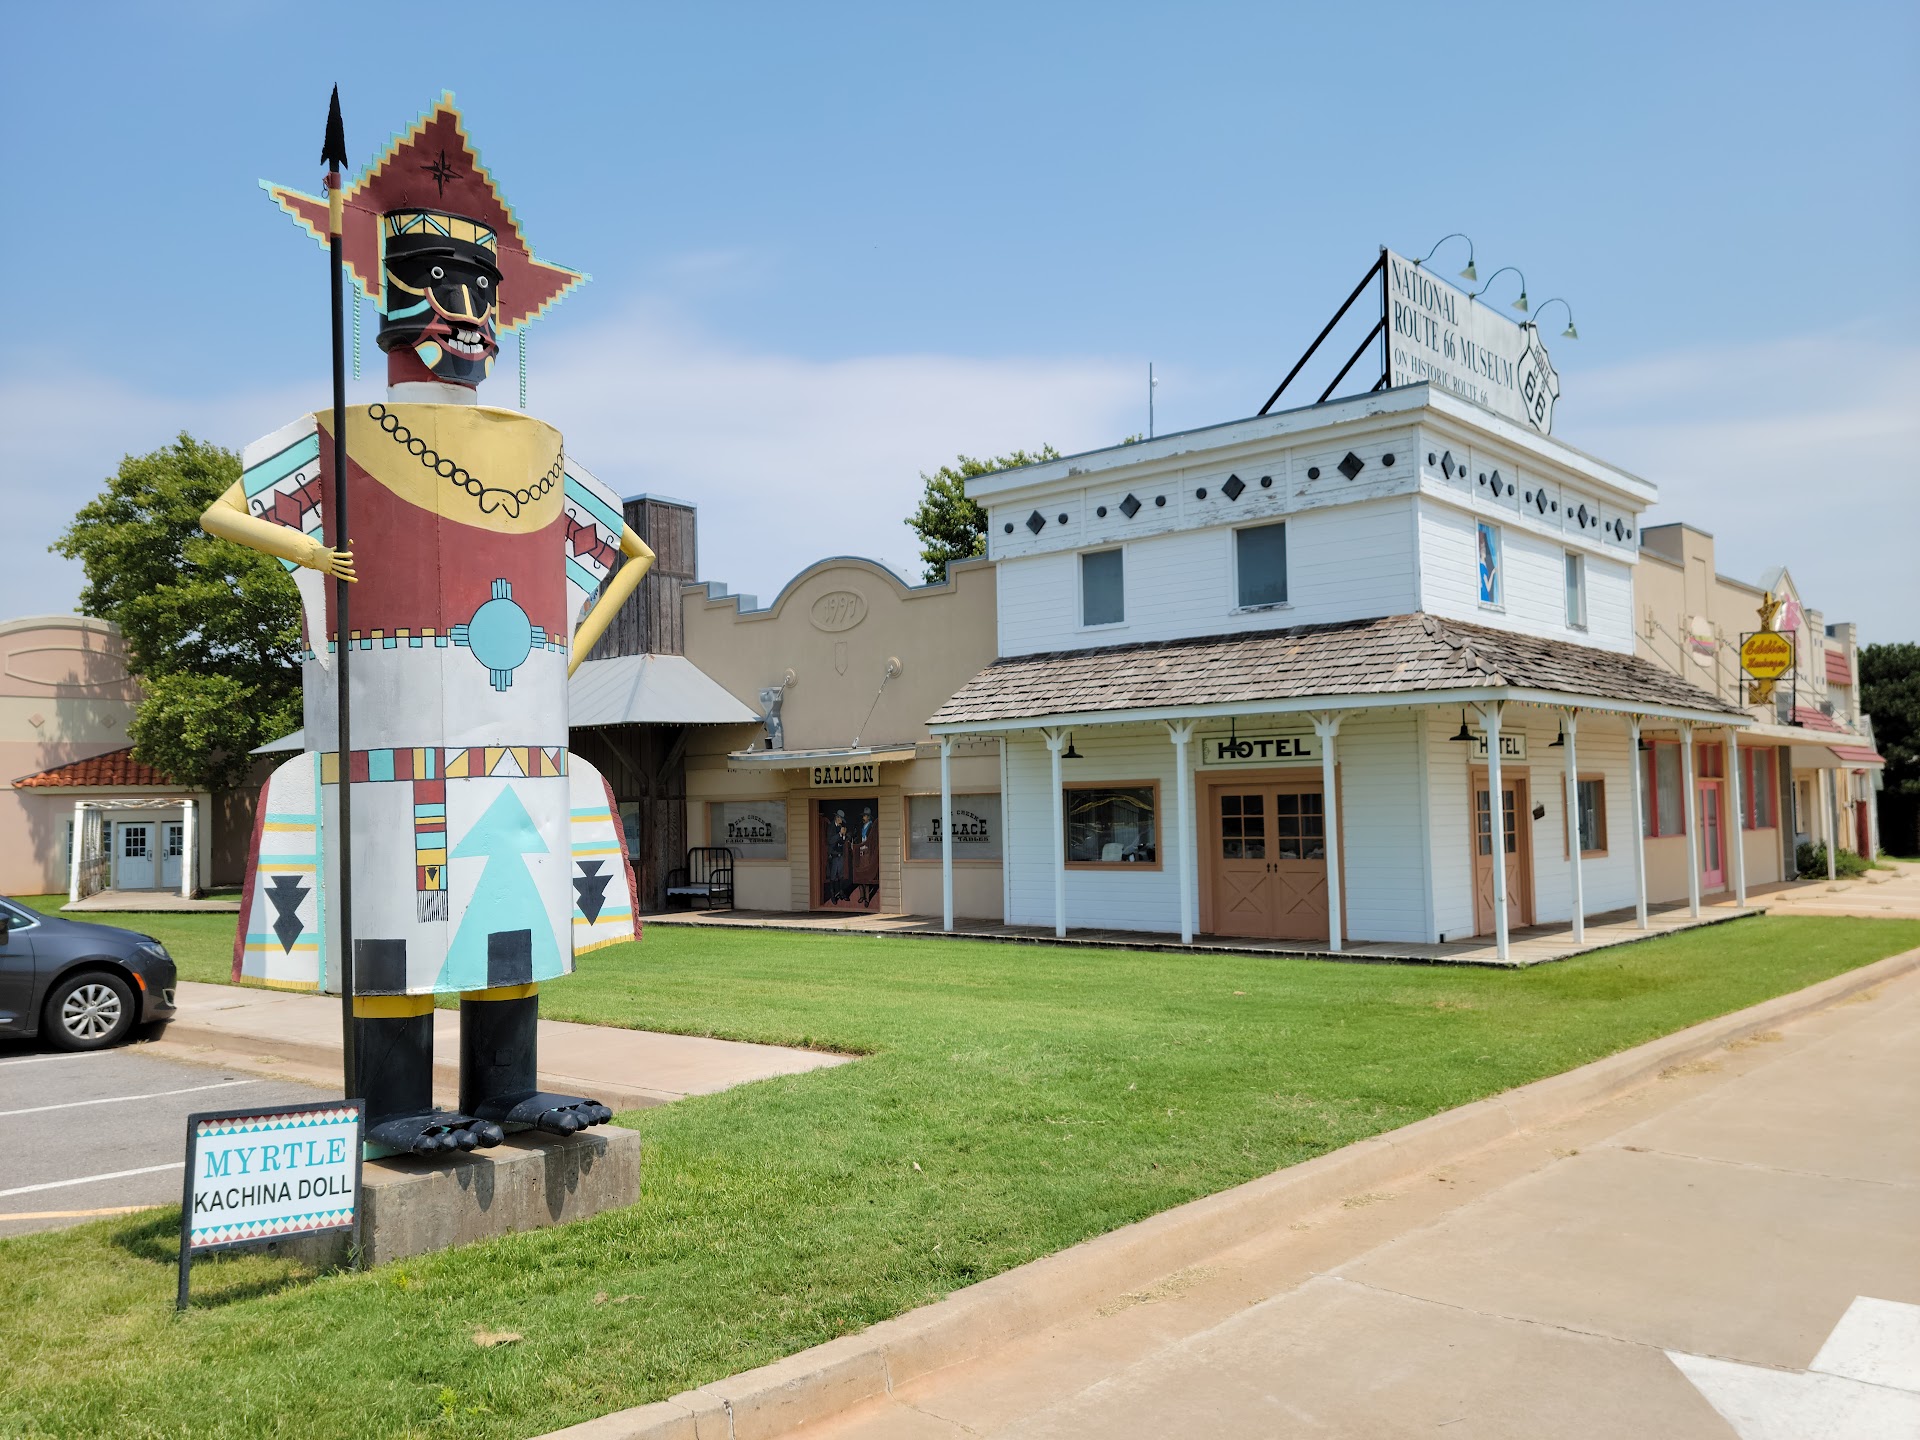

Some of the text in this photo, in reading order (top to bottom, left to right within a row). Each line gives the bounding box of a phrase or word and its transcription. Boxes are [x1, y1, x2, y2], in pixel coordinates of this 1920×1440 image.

[1391, 258, 1459, 327] NATIONAL
[1394, 300, 1513, 390] ROUTE 66 MUSEUM
[1534, 344, 1551, 384] ROUTE
[1395, 347, 1408, 368] ON
[1411, 355, 1450, 390] HISTORIC
[1453, 375, 1478, 401] ROUTE
[1525, 370, 1546, 423] 66
[1217, 738, 1311, 759] HOTEL
[1480, 735, 1520, 755] HTEL
[814, 765, 874, 785] SALOON
[728, 822, 772, 838] PALACE
[931, 818, 987, 836] PLACE
[203, 1137, 346, 1179] MYRTLE
[194, 1174, 352, 1214] KACHINA DOLL
